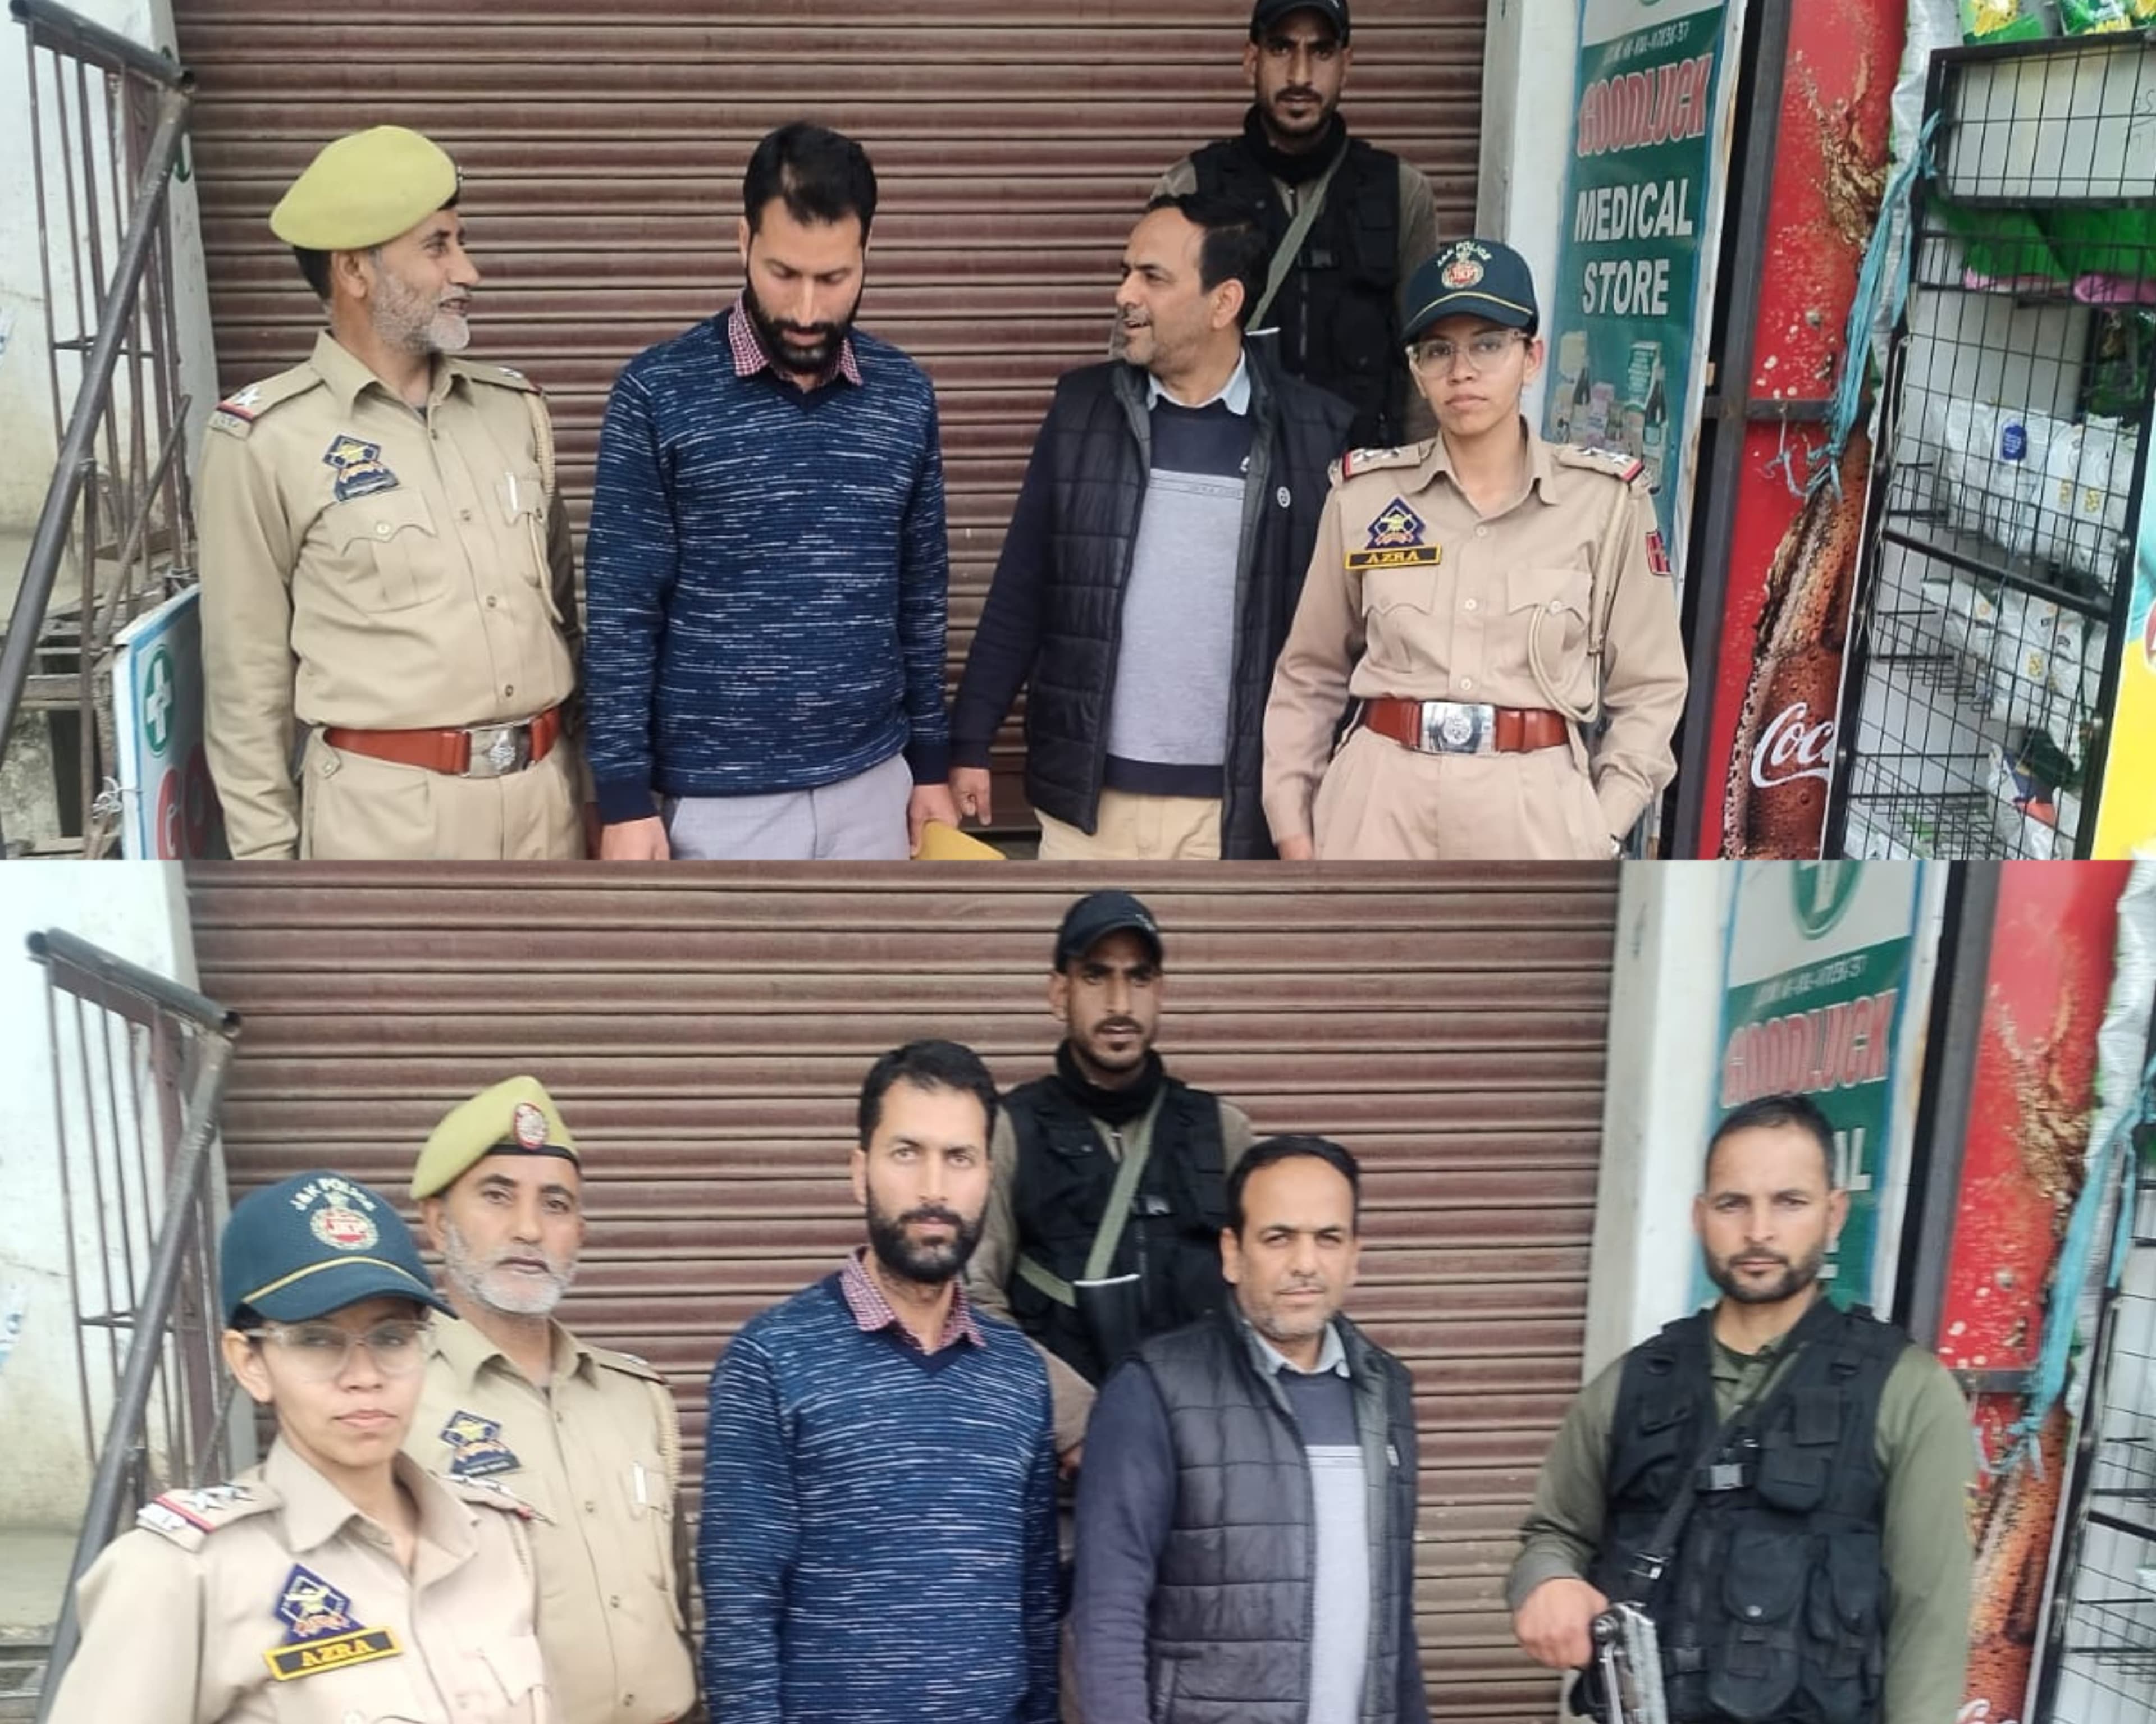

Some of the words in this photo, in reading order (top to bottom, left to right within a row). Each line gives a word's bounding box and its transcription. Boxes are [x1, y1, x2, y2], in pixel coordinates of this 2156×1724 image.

[1577, 53, 1713, 158] GOODLUCK
[1574, 179, 1692, 243] MEDICAL
[1582, 259, 1669, 315] STORE
[1367, 550, 1420, 564] AZRA
[302, 1638, 376, 1667] AZRA
